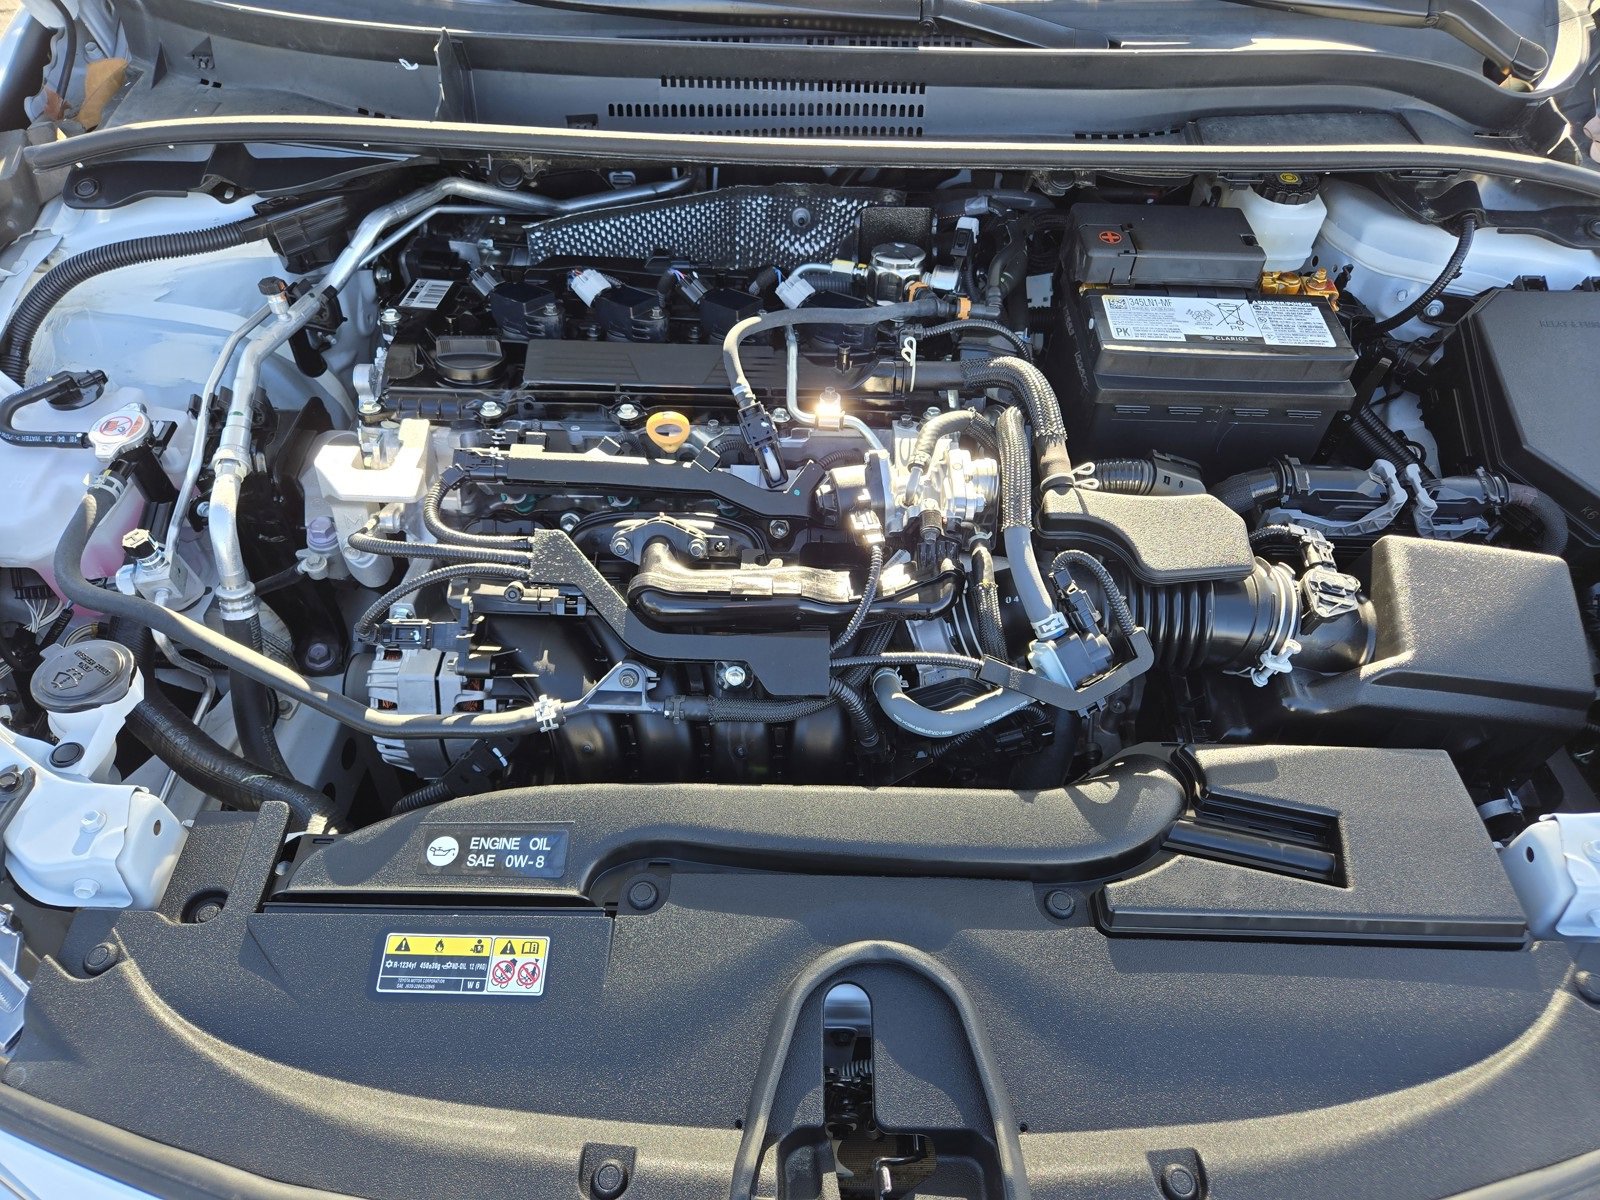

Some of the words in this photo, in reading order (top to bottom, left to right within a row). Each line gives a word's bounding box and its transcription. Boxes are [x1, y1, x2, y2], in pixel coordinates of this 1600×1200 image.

[1116, 327, 1131, 337] PK
[470, 837, 521, 850] ENGINE
[529, 837, 551, 850] OIL
[466, 854, 496, 867] SAE
[505, 855, 545, 868] 0W-8
[393, 962, 417, 970] R-1234yf
[467, 981, 474, 989] W
[475, 981, 480, 989] 6
